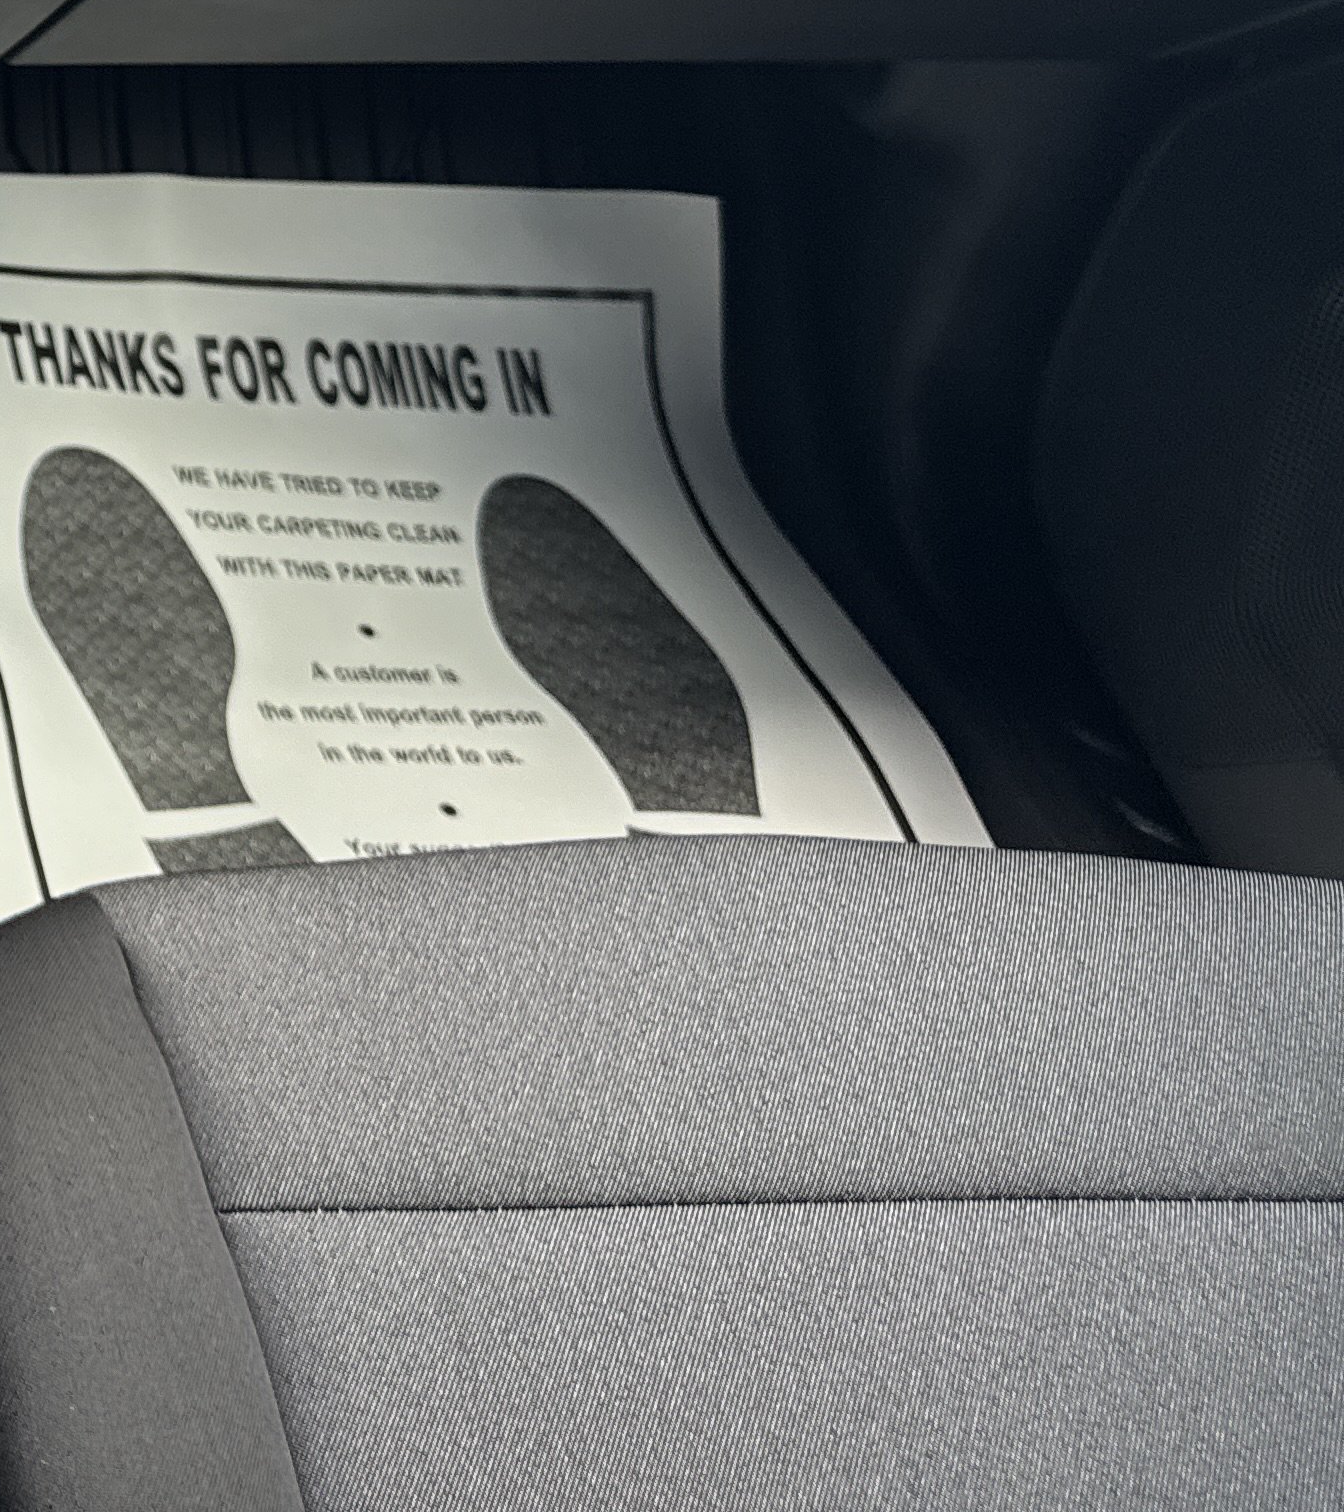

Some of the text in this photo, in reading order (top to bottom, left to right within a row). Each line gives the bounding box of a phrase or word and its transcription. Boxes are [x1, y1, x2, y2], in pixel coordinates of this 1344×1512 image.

[195, 334, 297, 406] FOR
[306, 337, 489, 415] COMING
[497, 346, 553, 417] IN
[172, 465, 441, 502] WE HAVE TRIED TO KEEP
[185, 508, 463, 546] YOUR CARPETING CLEAN
[216, 554, 466, 589] WITH THIS PAPER MAT
[310, 661, 460, 685] A customer is
[257, 700, 543, 730] the most important person
[318, 742, 345, 763] in
[348, 743, 383, 764] the
[390, 743, 452, 765] world
[456, 746, 481, 765] to
